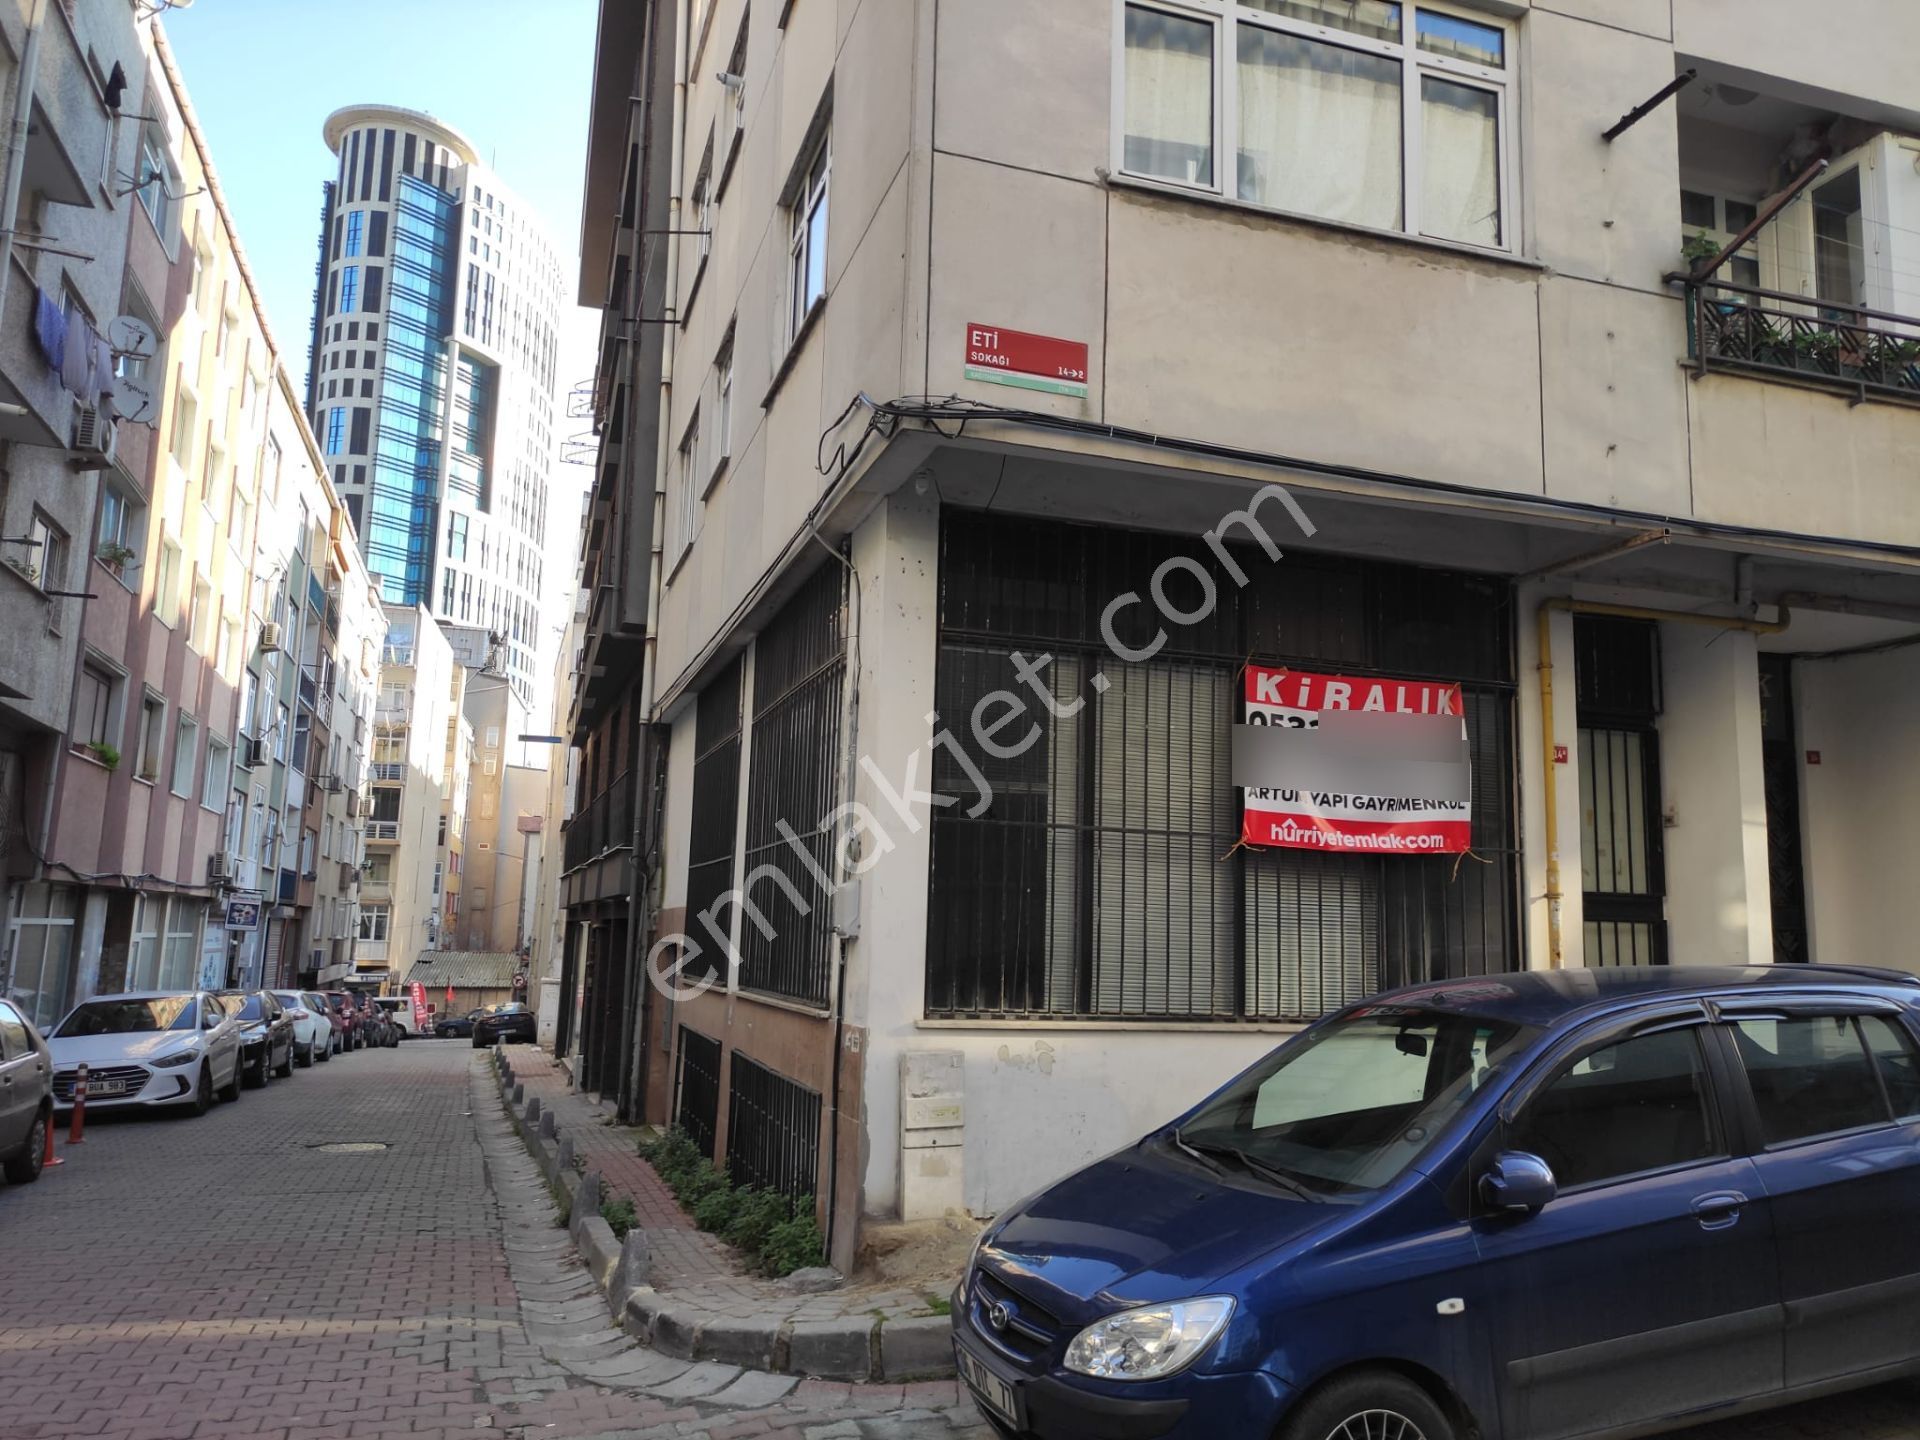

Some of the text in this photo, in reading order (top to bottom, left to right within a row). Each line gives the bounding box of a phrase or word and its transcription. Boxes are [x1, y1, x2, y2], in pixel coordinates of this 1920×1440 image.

[972, 331, 998, 349] ETİ
[971, 352, 1009, 366] SOKAĞI
[1310, 791, 1348, 809] YAPI
